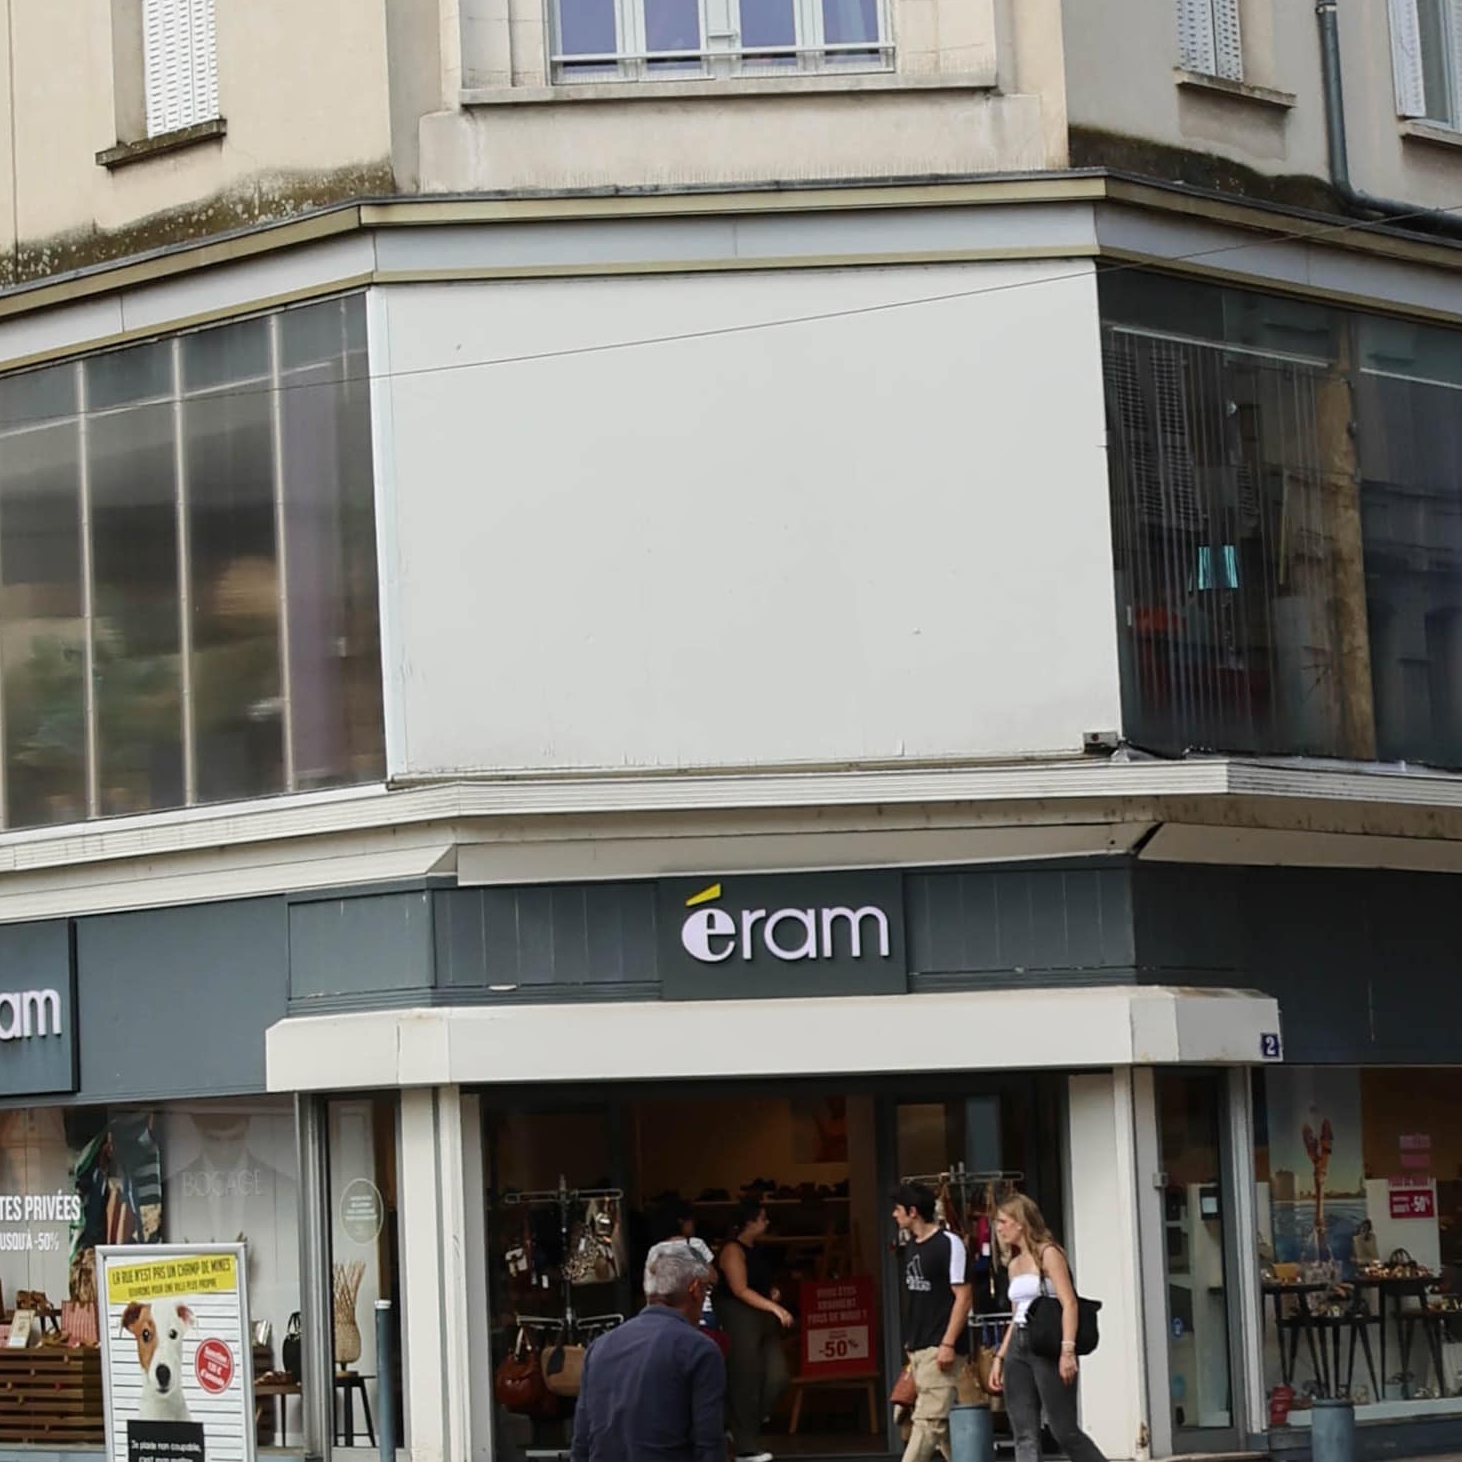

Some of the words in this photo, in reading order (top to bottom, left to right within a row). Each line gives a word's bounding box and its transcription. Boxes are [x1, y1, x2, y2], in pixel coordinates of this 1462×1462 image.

[681, 883, 890, 963] éram
[1266, 1036, 1277, 1055] 2
[24, 1189, 81, 1222] PRIVÉES
[34, 1232, 60, 1251] -50%
